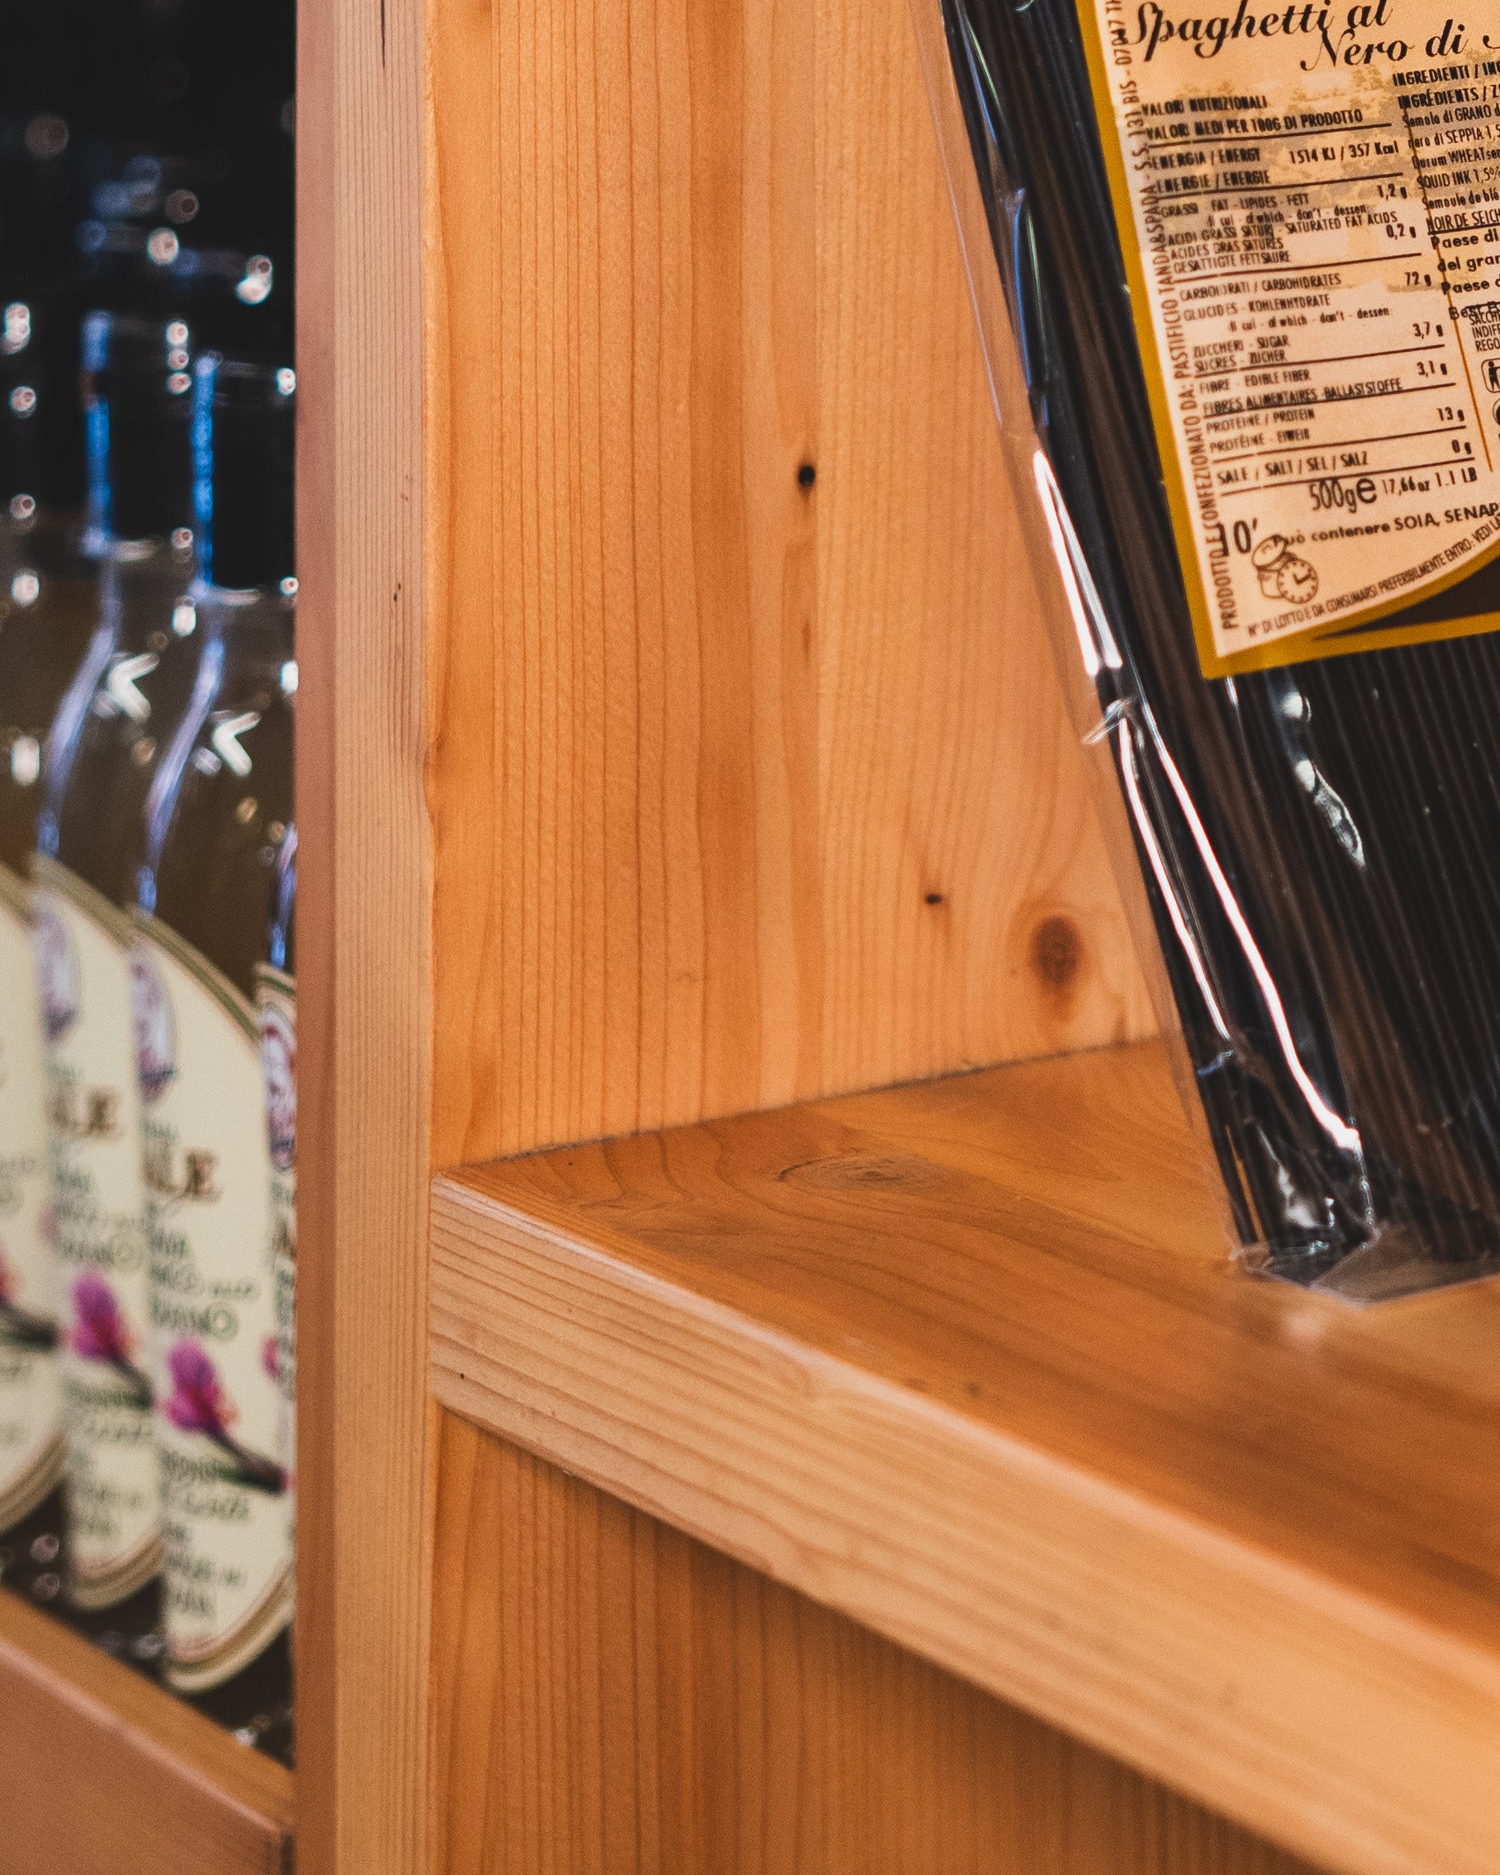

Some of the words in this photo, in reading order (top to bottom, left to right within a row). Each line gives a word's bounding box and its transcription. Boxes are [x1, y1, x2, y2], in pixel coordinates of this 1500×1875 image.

[1299, 28, 1415, 71] Nero
[1425, 18, 1468, 58] di
[1392, 64, 1471, 86] INGREDIENTI
[1120, 80, 1140, 104] BIS
[1398, 87, 1479, 109] INGRÉDIENTS
[1189, 95, 1268, 112] NUTRIZIONALI
[1226, 118, 1249, 134] PER
[1283, 115, 1298, 130] DI
[1300, 108, 1364, 128] PRODOTTO
[1443, 109, 1453, 123] di
[1455, 105, 1492, 121] GRANO
[1445, 125, 1486, 144] SEPPIA
[1349, 143, 1370, 158] 357
[1448, 146, 1486, 164] WHEAT
[1416, 172, 1451, 190] SQUID
[1452, 169, 1472, 185] INK
[1377, 183, 1396, 201] 1,2
[1422, 192, 1467, 210] Semoule
[1469, 190, 1482, 204] de
[1482, 186, 1500, 202] blé
[1345, 214, 1363, 228] FAT
[1367, 211, 1398, 226] ACIDS
[1426, 215, 1455, 232] NOIR
[1454, 212, 1469, 228] DE
[1386, 223, 1405, 240] 0,2
[1430, 233, 1479, 250] Paese
[1484, 228, 1499, 242] di
[1437, 257, 1461, 273] del
[1405, 271, 1420, 286] 72
[1441, 279, 1490, 295] Paese
[1160, 299, 1191, 379] PASTIFICIO
[1412, 321, 1430, 339] 3,7
[1244, 371, 1280, 387] EDIBLE
[1417, 360, 1435, 378] 3,1
[1437, 406, 1453, 421] 13
[1182, 415, 1219, 529] CONFEZIONATO
[1265, 460, 1294, 477] SALT
[1461, 467, 1478, 483] LB
[1311, 522, 1391, 541] contenere
[1394, 512, 1440, 531] SOIA,
[1444, 538, 1476, 562] ENTRO:
[1471, 523, 1494, 544] VEDI
[1209, 549, 1238, 629] PRODOTTO
